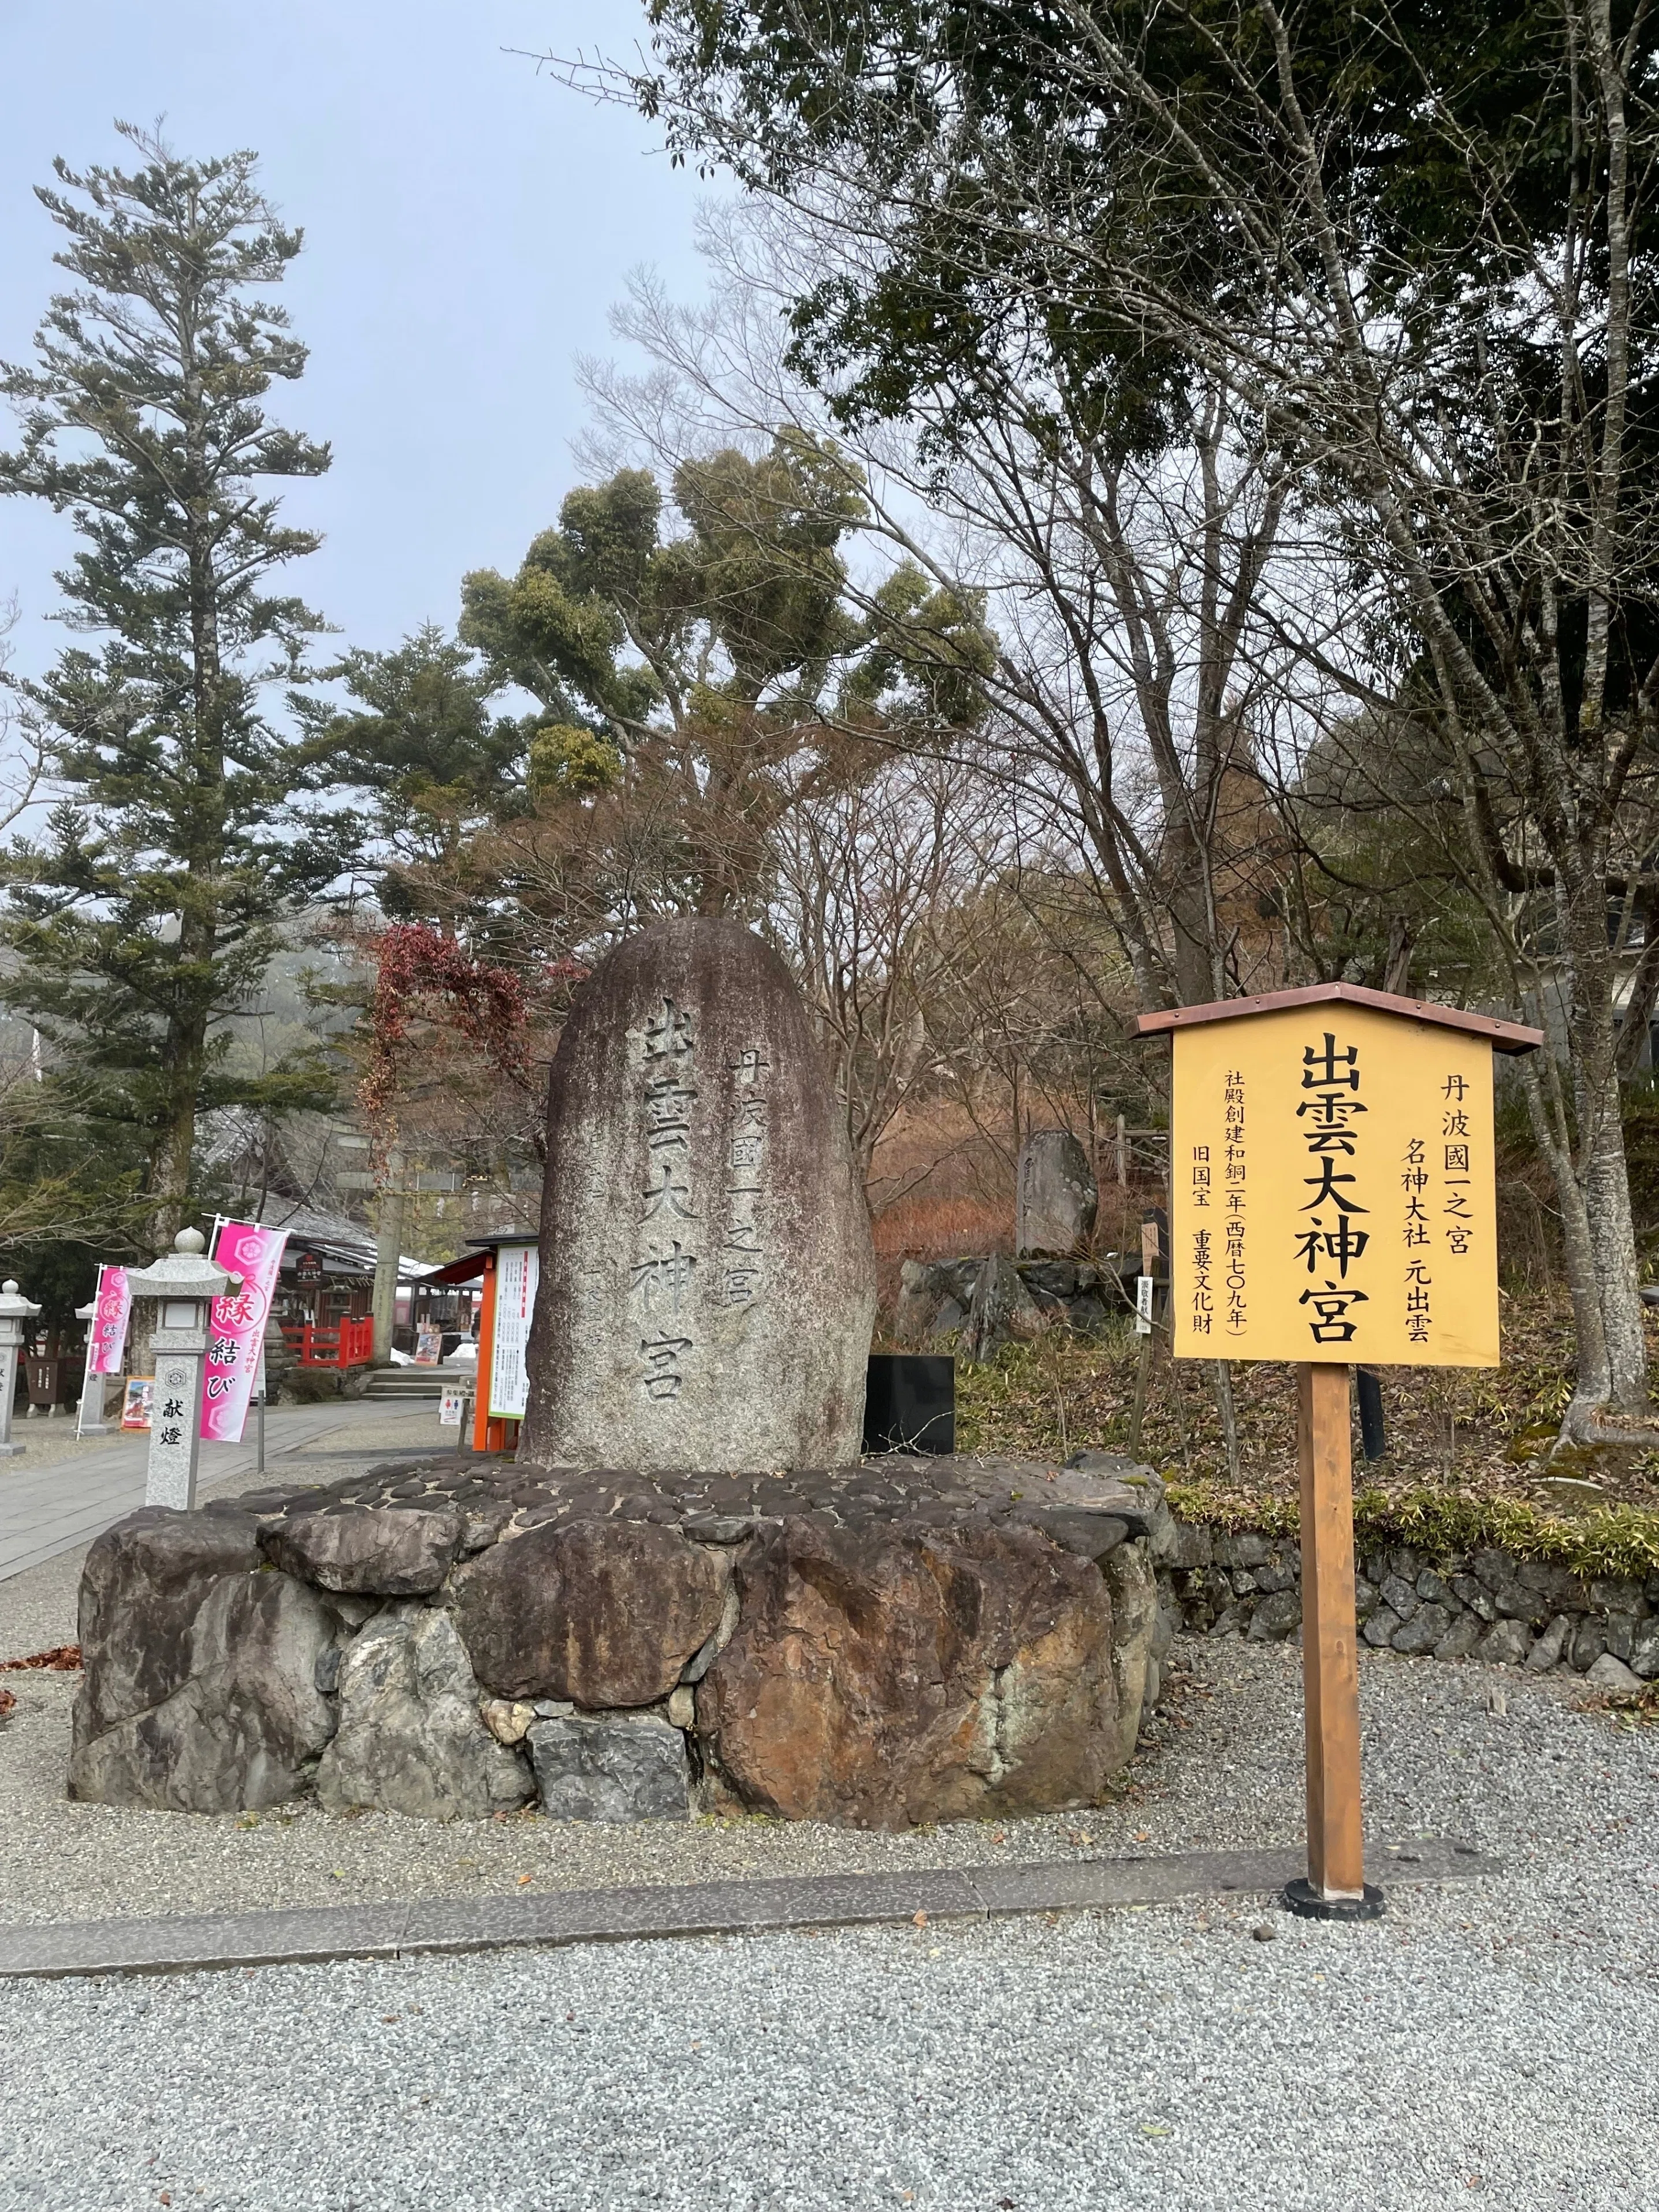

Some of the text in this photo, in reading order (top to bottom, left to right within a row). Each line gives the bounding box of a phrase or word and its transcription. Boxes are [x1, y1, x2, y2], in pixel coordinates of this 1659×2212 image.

[631, 996, 700, 1402] 出雲大神宮
[721, 1048, 770, 1306] 丹波國一之宮
[1192, 1146, 1214, 1335] 旧国宝 重要文化財
[1293, 1032, 1371, 1344] 出雲大神宮
[1401, 1138, 1433, 1343] 名神大社 元出雲
[1440, 1075, 1474, 1254] 丹波國一之宮
[159, 1398, 184, 1445] 献燈
[209, 1293, 254, 1398] 縁結び
[244, 1329, 260, 1373] 出雲大神宮
